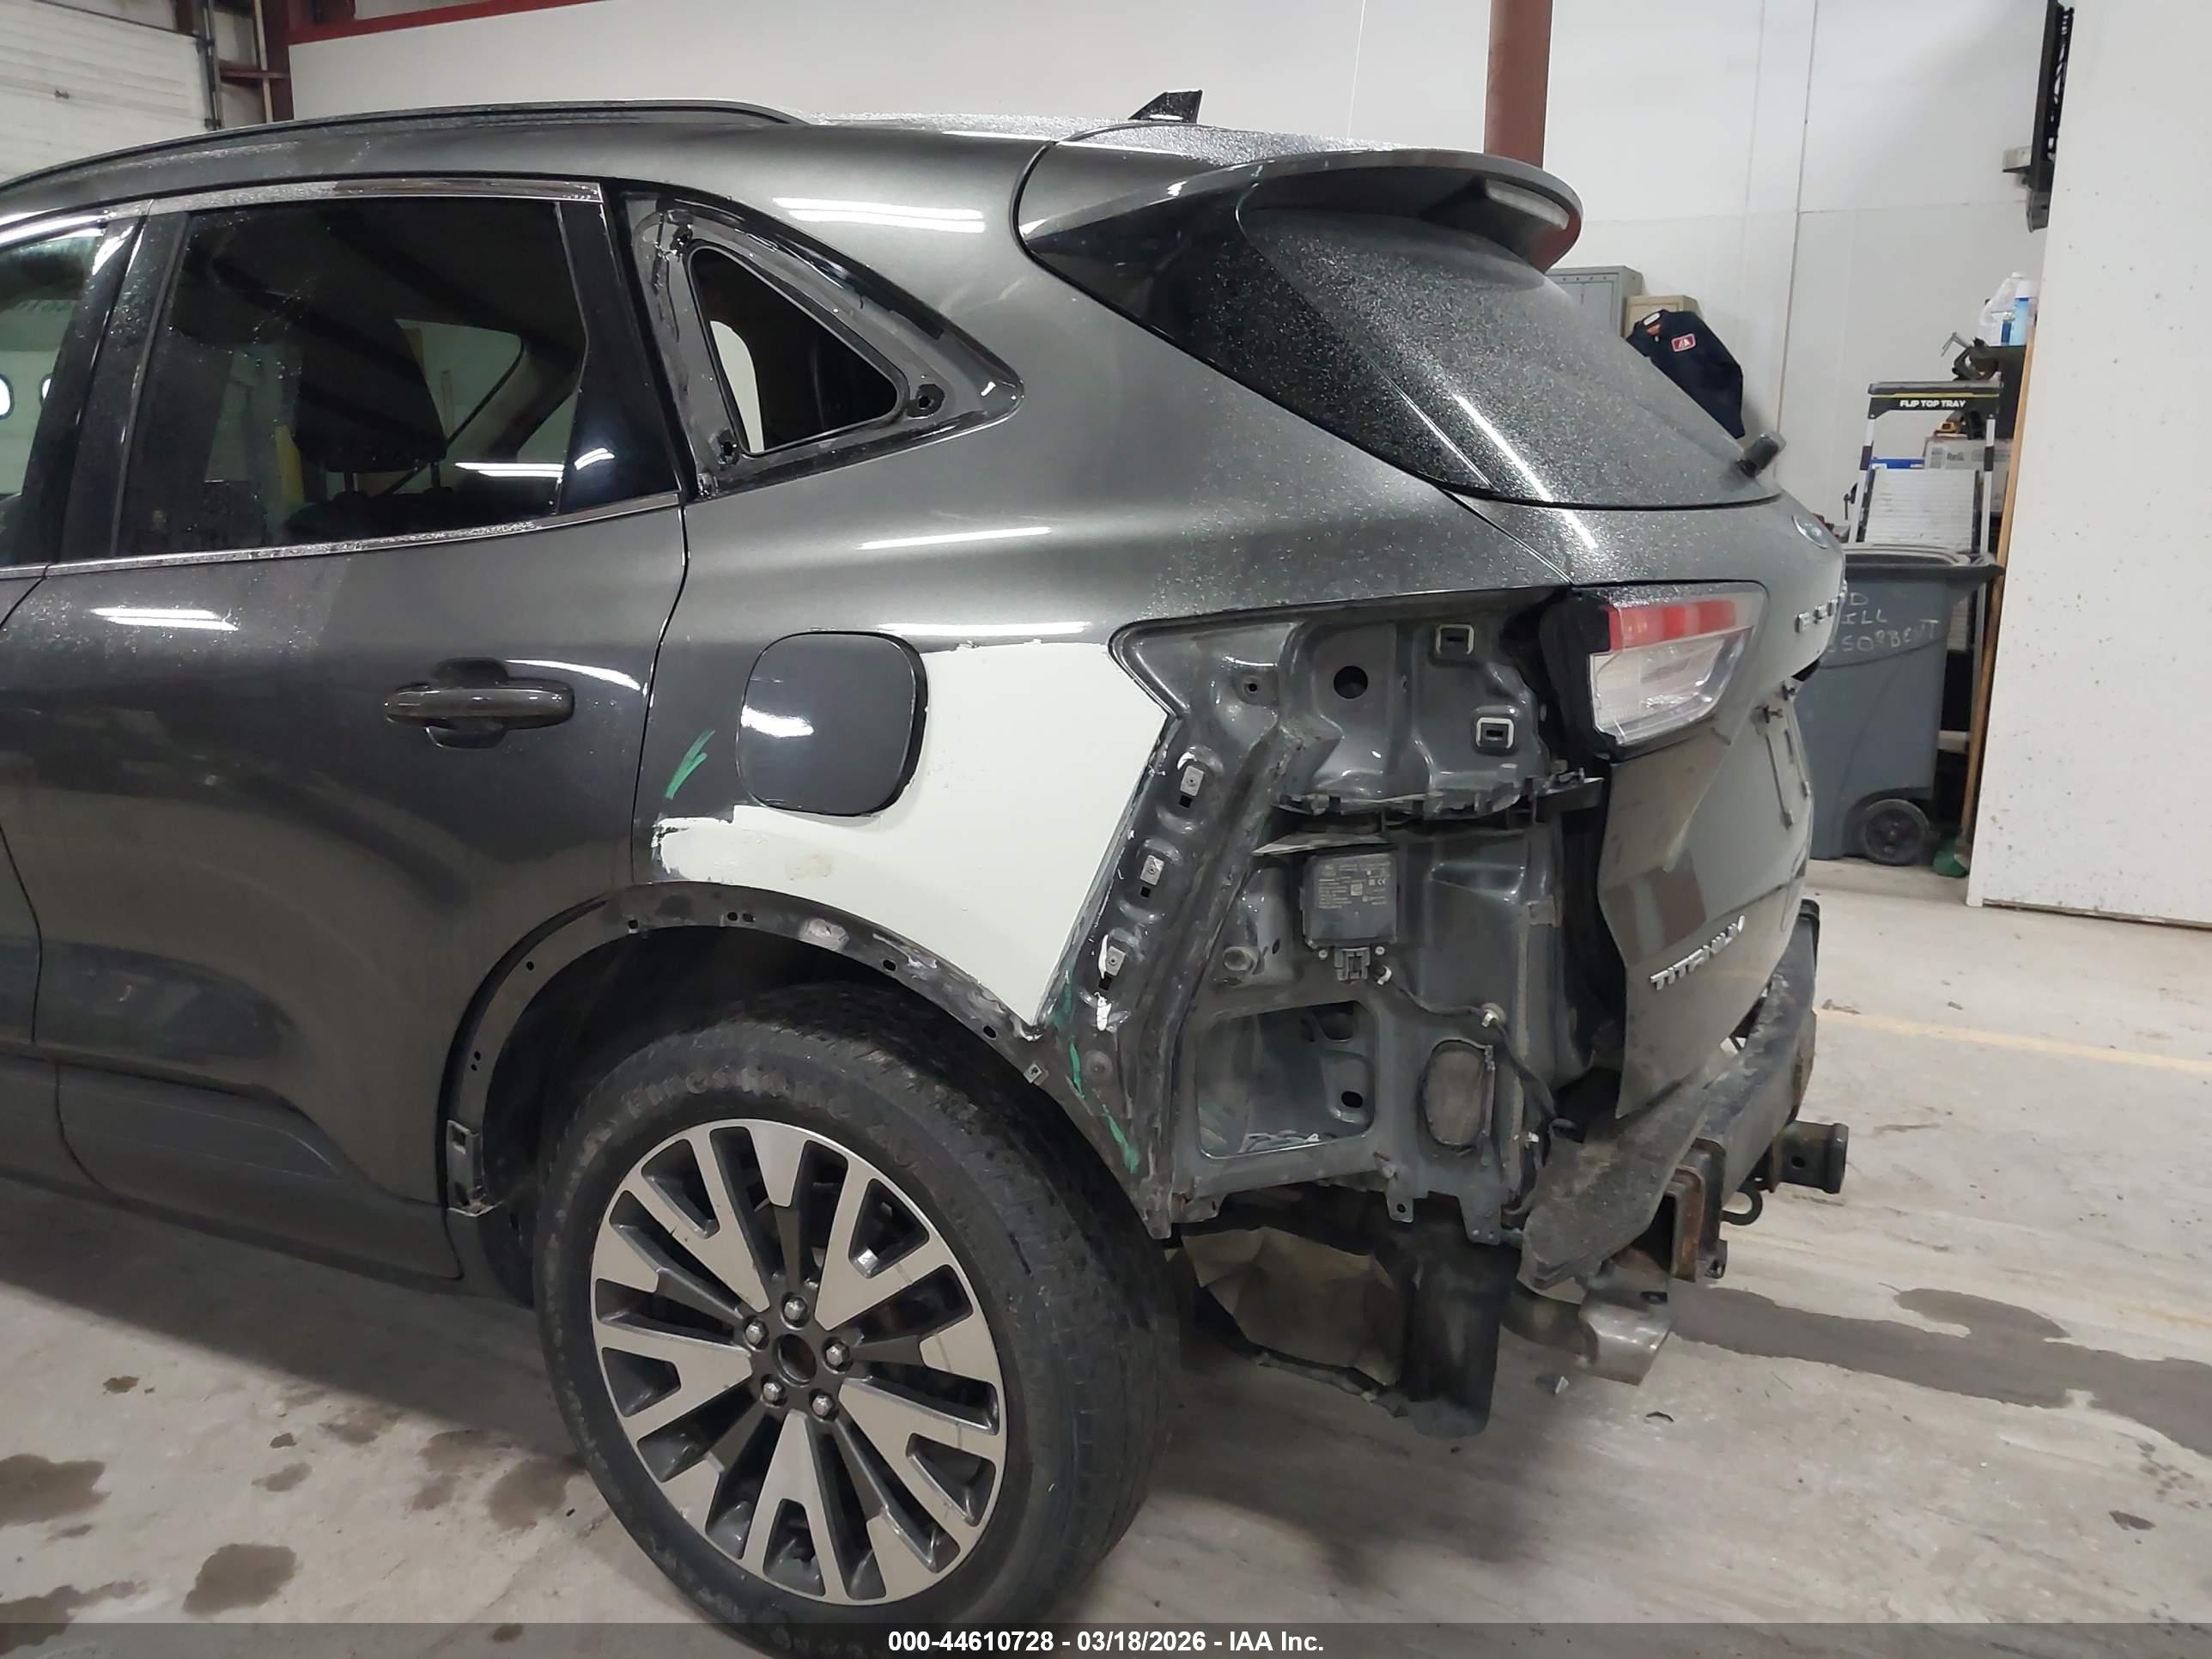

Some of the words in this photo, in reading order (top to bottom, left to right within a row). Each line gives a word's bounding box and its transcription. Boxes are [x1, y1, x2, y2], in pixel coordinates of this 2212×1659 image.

[1899, 399, 1920, 408] FLIP
[1920, 399, 1940, 408] TOP
[1941, 399, 1966, 408] TRAY
[1840, 608, 1888, 625] ILL
